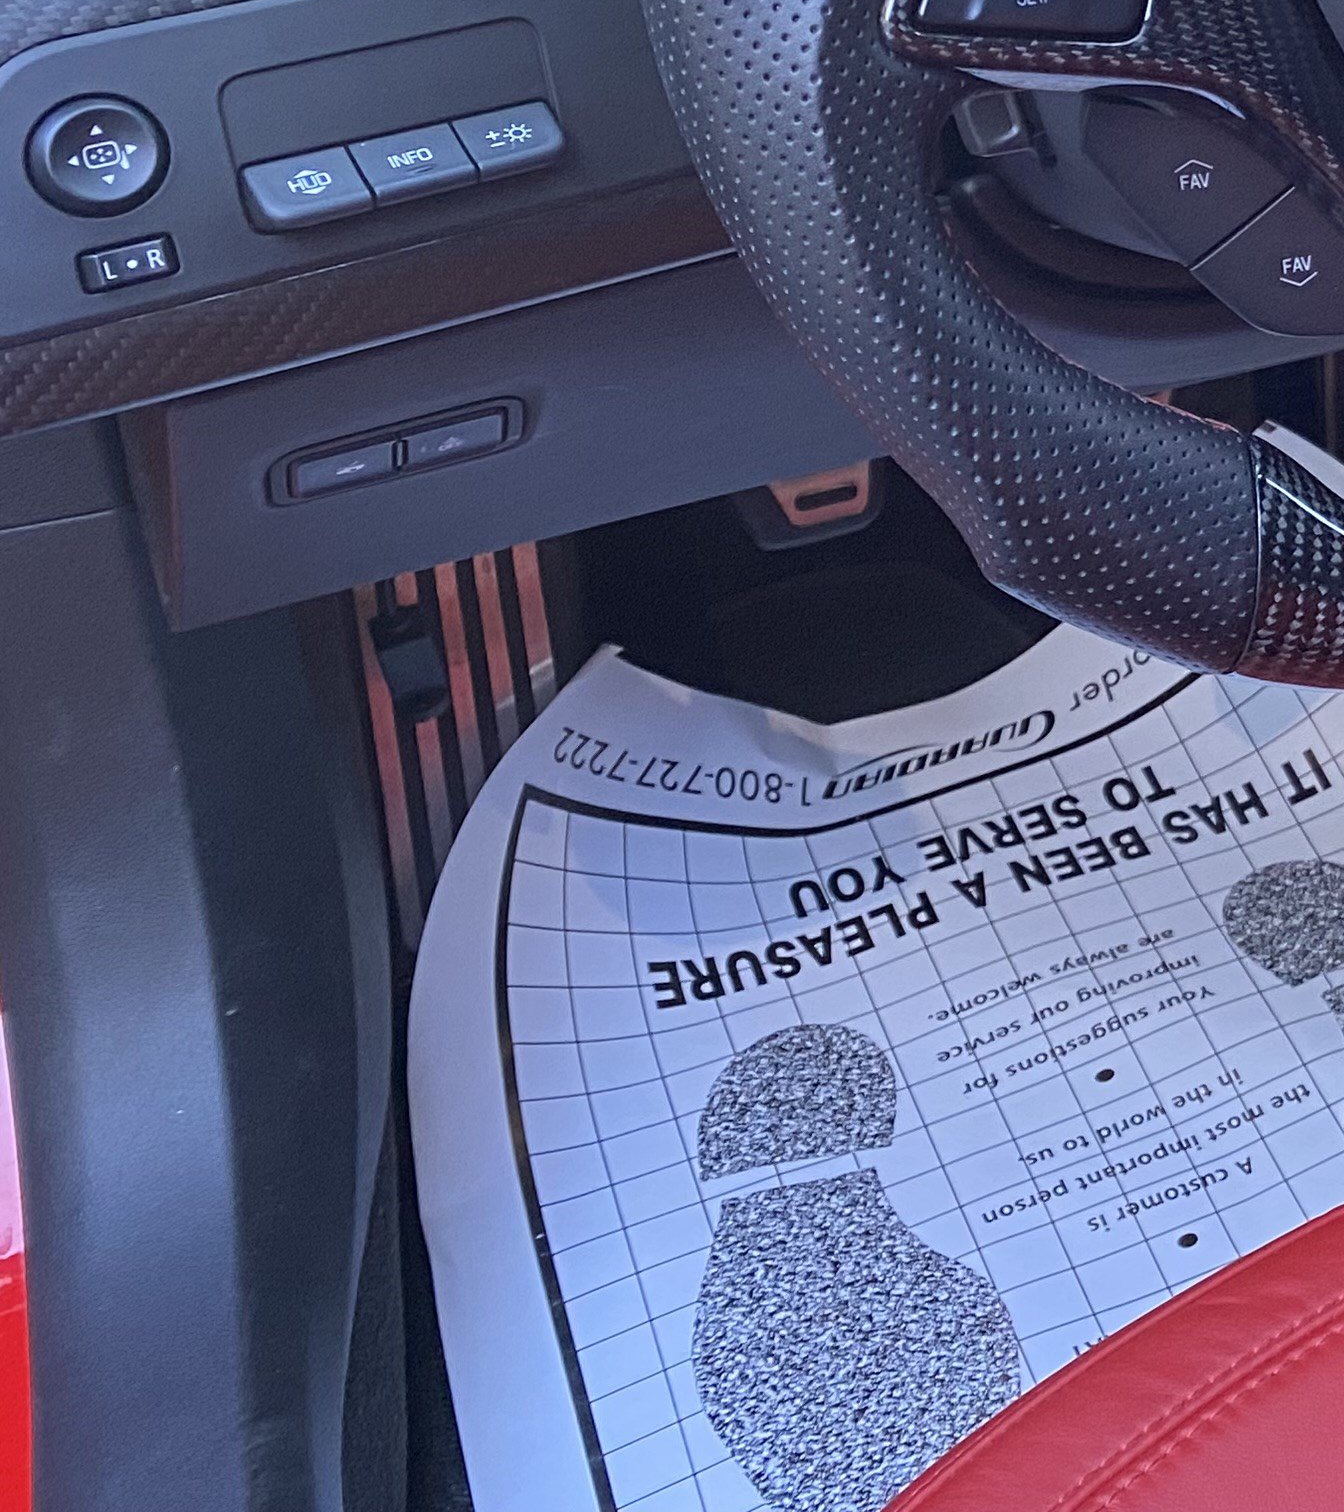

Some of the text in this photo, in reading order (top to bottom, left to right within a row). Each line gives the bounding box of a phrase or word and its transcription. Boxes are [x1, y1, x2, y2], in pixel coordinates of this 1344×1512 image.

[287, 171, 332, 194] HUD
[387, 146, 433, 170] INFO
[1179, 172, 1211, 191] FAV
[103, 248, 166, 281] L R
[1282, 255, 1312, 275] FAV
[554, 726, 812, 807] 1-800-727-7222
[646, 747, 1333, 1010] IT HAS BEEN A PLEASURE
[788, 766, 1177, 919] TO SERVE YOU
[927, 928, 1175, 1022] are always welcome.
[936, 953, 1200, 1063] improving our service
[962, 986, 1216, 1095] Your suggestions for
[981, 1084, 1311, 1226] the most important person
[1018, 1068, 1245, 1166] in the world to us.
[1087, 1156, 1255, 1233] A customer is
